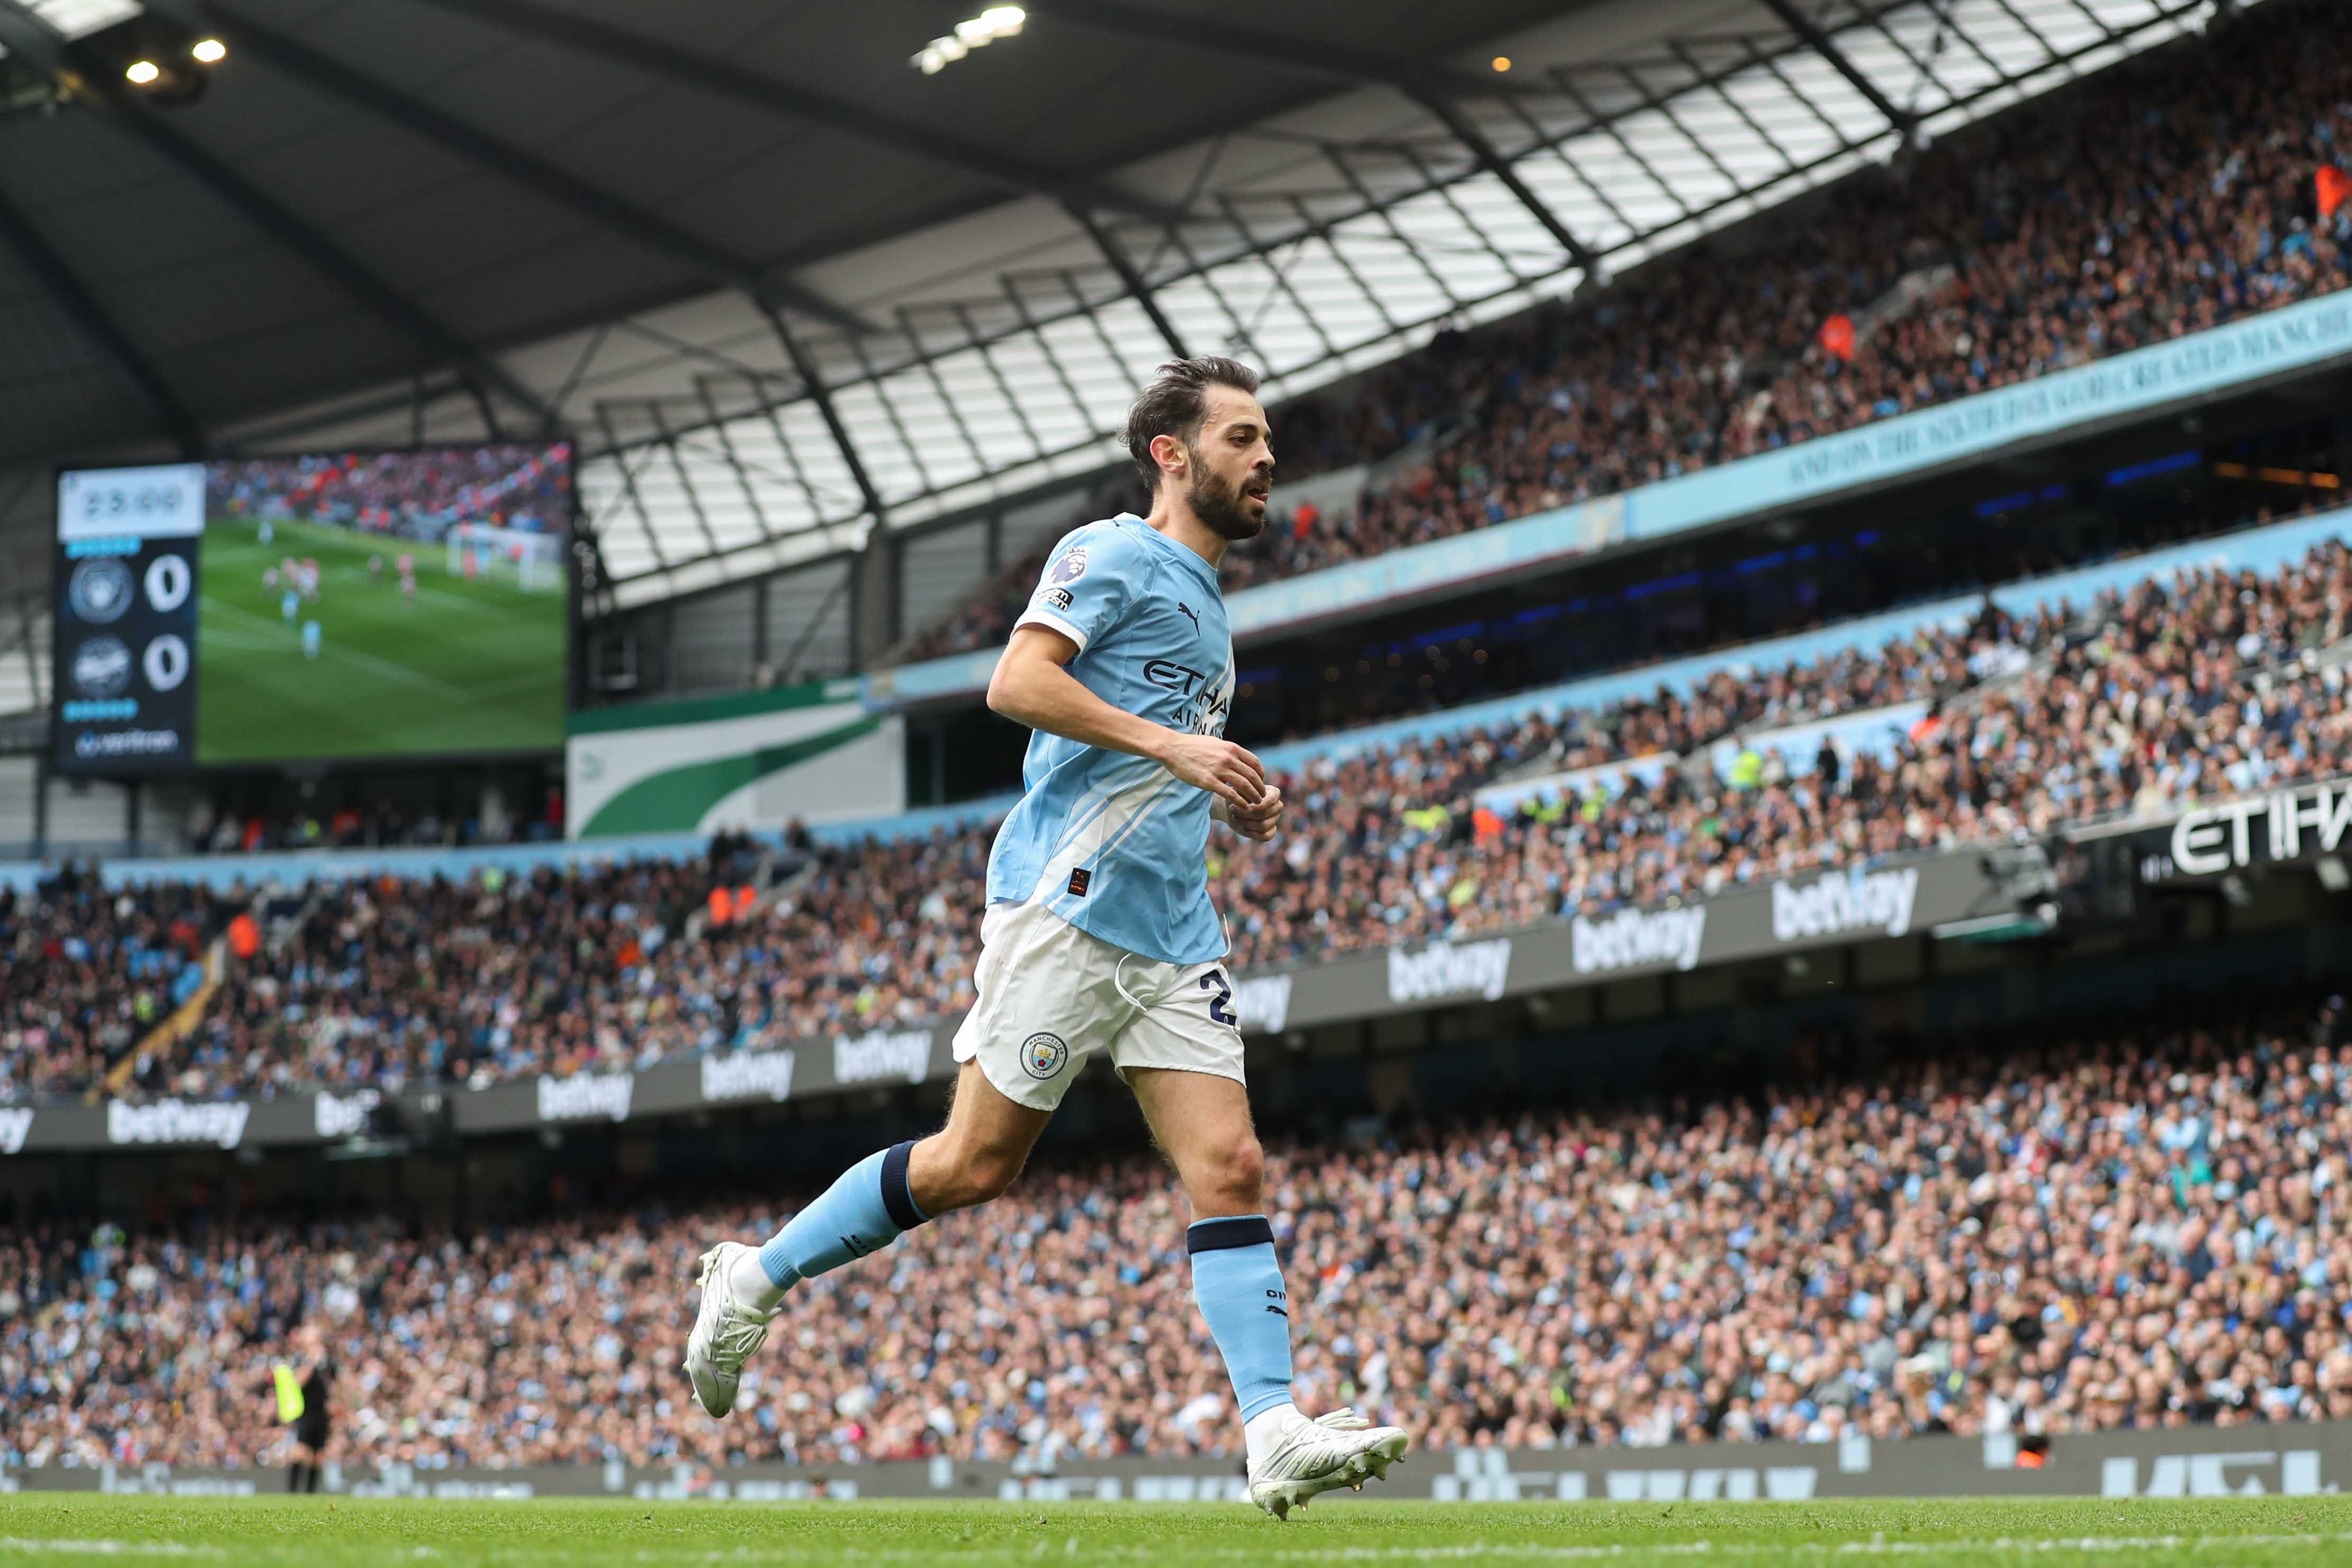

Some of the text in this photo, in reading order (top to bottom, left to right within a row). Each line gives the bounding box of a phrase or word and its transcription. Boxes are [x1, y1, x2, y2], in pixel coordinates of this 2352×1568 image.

[144, 554, 190, 612] 0
[143, 634, 189, 692] 0
[1143, 660, 1228, 717] ETIHA
[1773, 867, 1918, 941] betway
[1572, 906, 1707, 973] betway
[1389, 938, 1512, 1001] betway
[834, 1029, 933, 1084] betway
[1028, 1036, 1064, 1055] MANCHESTER
[537, 1072, 634, 1122] betway
[701, 1049, 795, 1103] betway
[108, 1098, 250, 1150] betway
